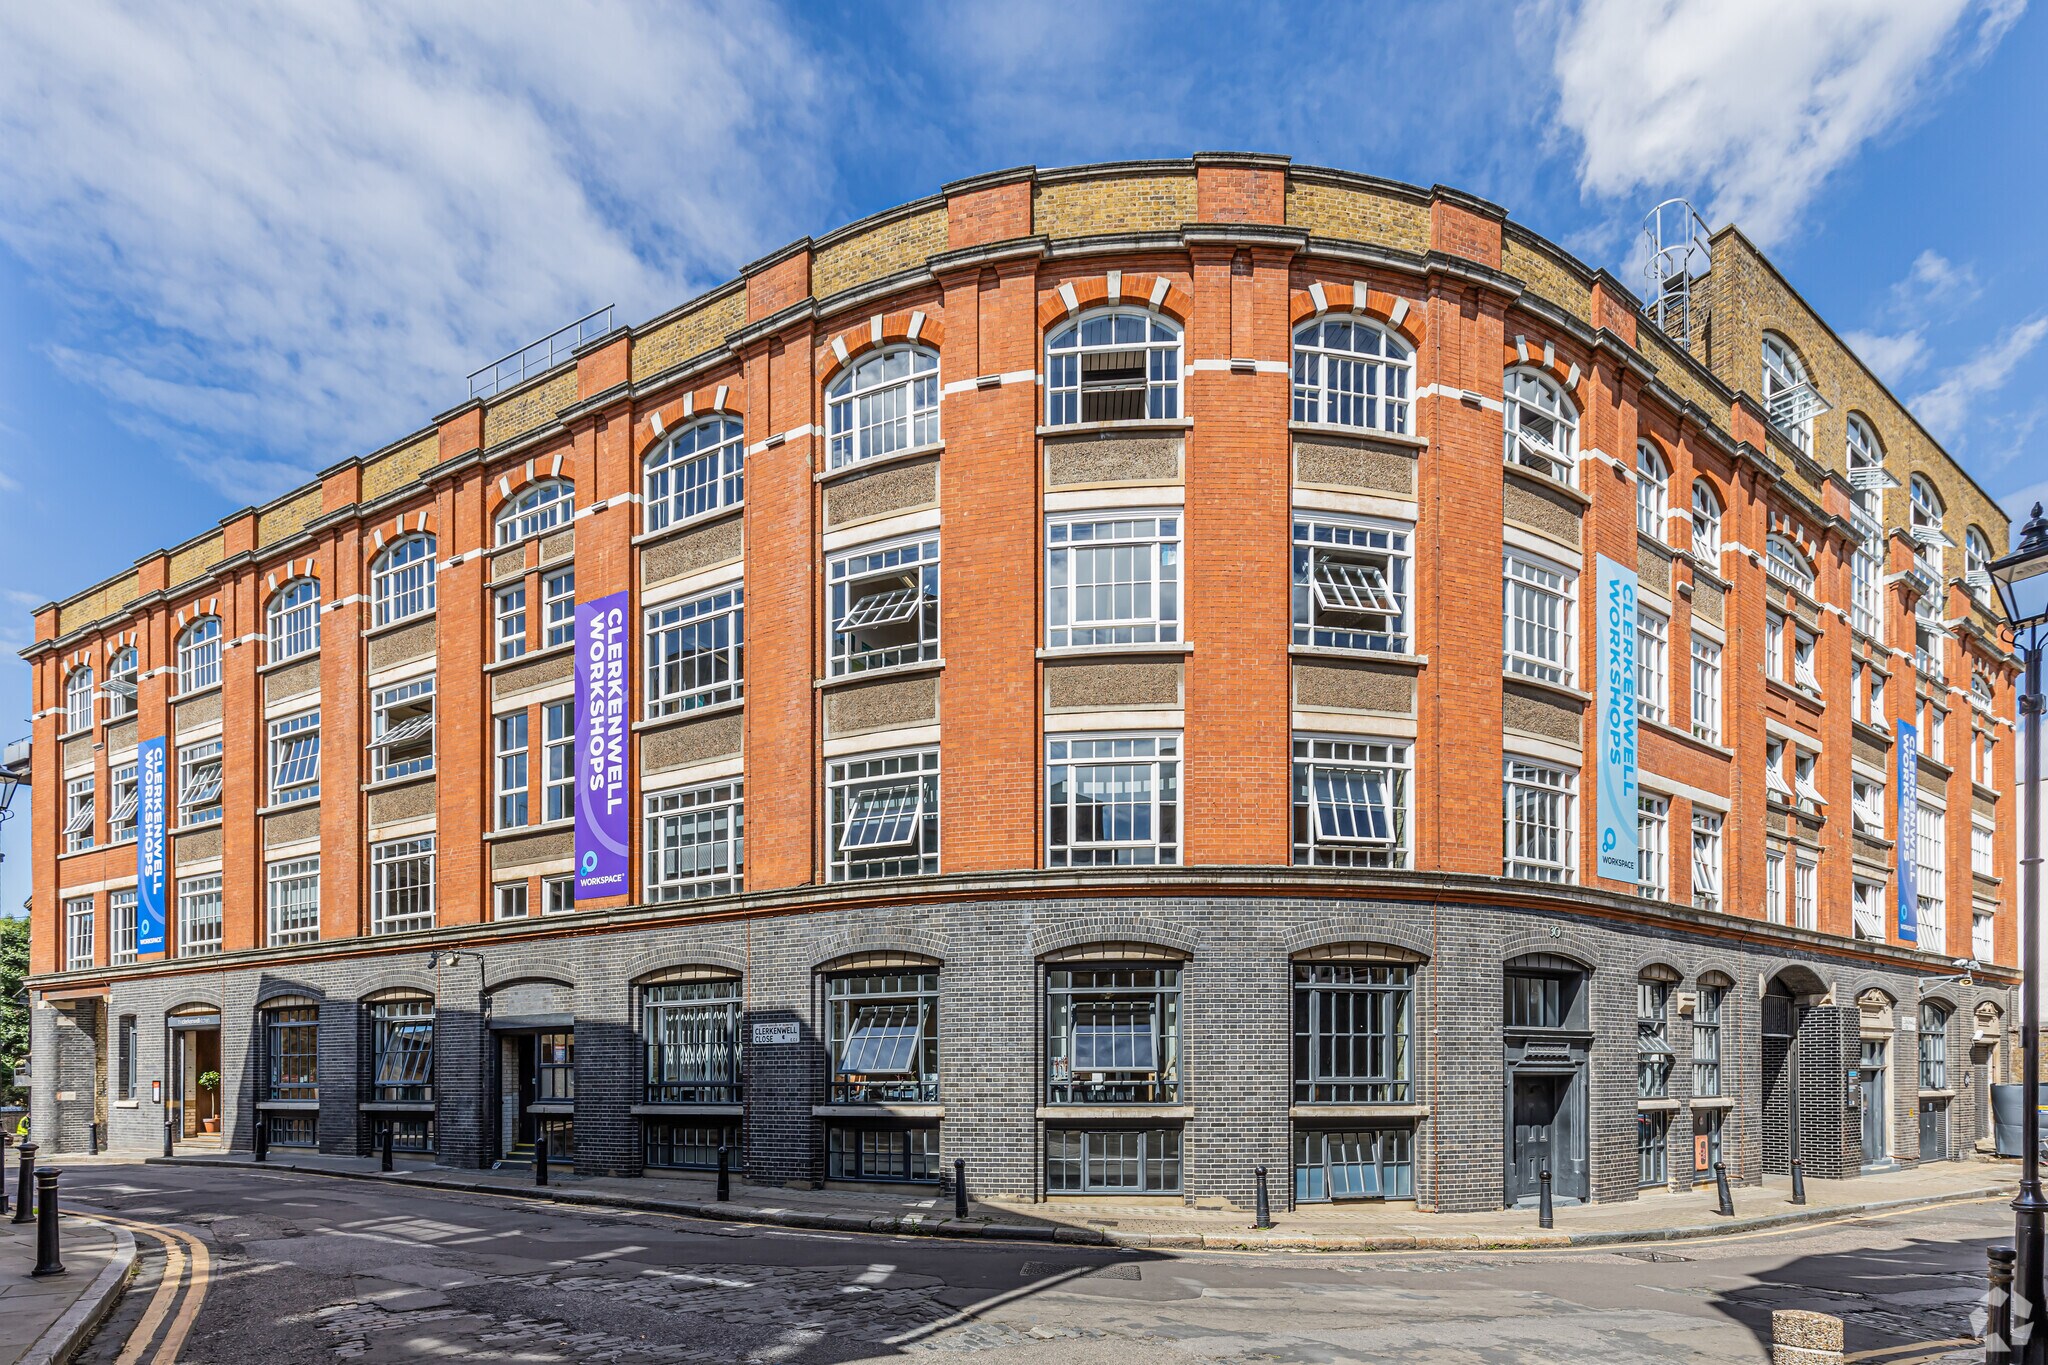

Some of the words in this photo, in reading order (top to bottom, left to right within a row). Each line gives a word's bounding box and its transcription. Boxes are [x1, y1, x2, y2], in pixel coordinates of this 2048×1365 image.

[590, 611, 605, 791] WORKSHOPS
[607, 608, 623, 815] CLERKENWELL
[1609, 580, 1621, 765] WORKSHOPS
[1622, 584, 1634, 797] CLERKENWELL
[144, 749, 153, 877] WORKSHOPS
[153, 747, 163, 895] CLERKENWELL
[1602, 855, 1634, 870] WORKSPACE
[1550, 926, 1560, 937] 30
[755, 1027, 797, 1035] CLERKENWELL
